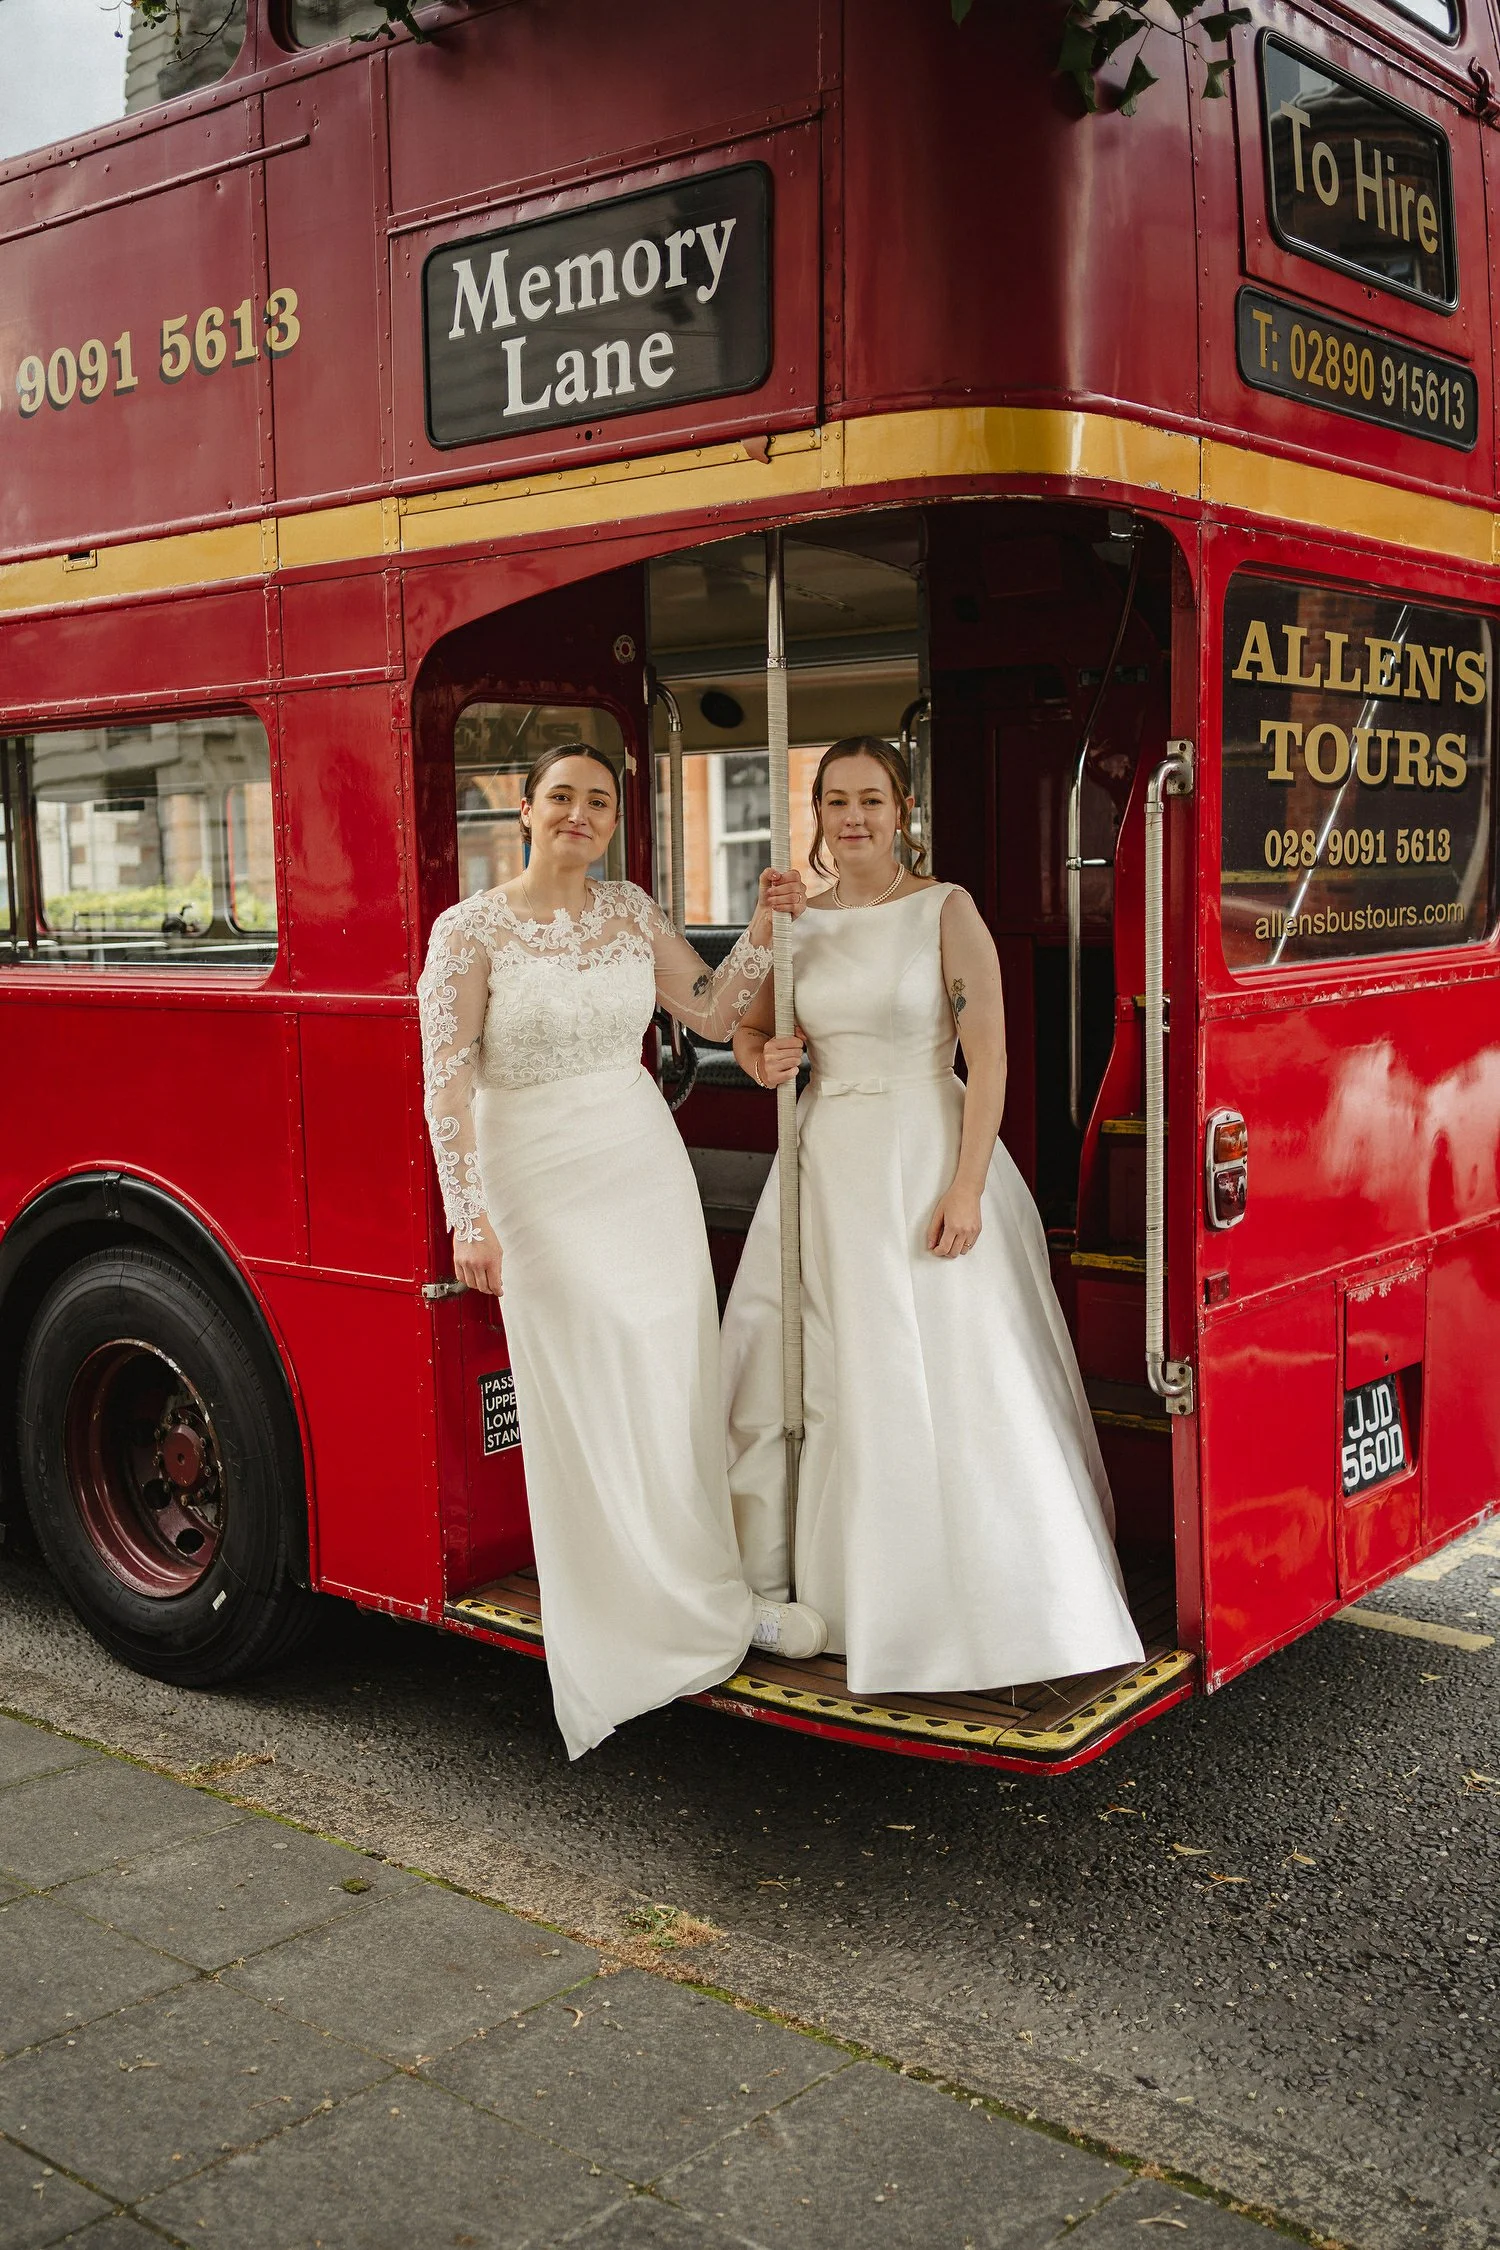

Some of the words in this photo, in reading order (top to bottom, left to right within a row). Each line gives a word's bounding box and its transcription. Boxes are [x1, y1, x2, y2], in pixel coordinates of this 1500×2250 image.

[1281, 102, 1340, 207] To
[1353, 138, 1439, 255] Hire
[448, 218, 737, 340] Memory
[16, 331, 138, 417] 9091
[160, 287, 300, 383] 5613
[502, 331, 675, 417] Lane
[1252, 309, 1279, 373] T:
[1290, 324, 1375, 401] 02890
[1381, 356, 1466, 431] 915613
[1232, 619, 1487, 706] ALLEN'S
[1260, 719, 1468, 789] TOURS
[1264, 829, 1318, 868] 028
[1327, 829, 1388, 866] 9091
[1396, 828, 1451, 865] 5613
[1255, 902, 1465, 941] allensbustours.com
[1348, 1383, 1393, 1440] JJD
[1341, 1423, 1404, 1488] 560D
